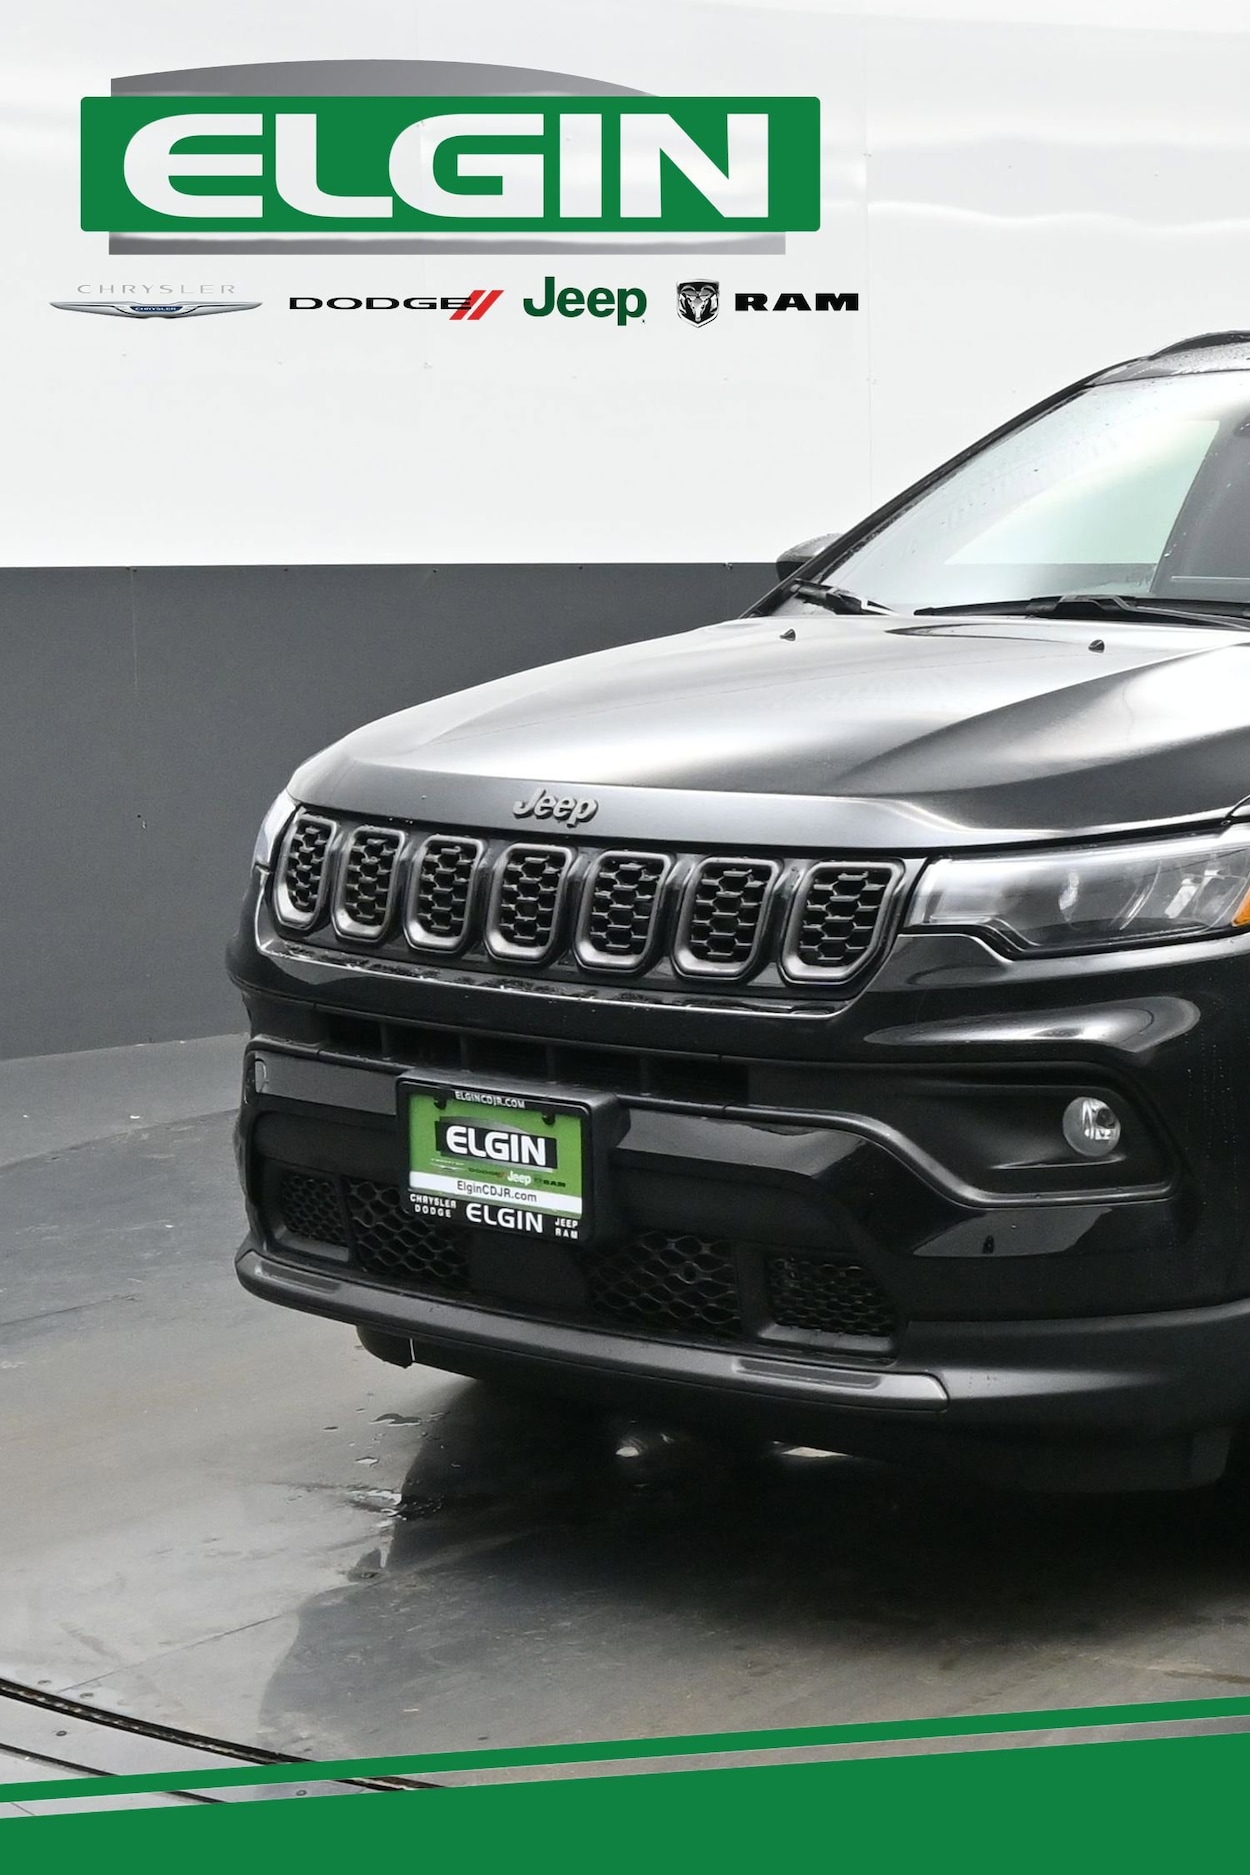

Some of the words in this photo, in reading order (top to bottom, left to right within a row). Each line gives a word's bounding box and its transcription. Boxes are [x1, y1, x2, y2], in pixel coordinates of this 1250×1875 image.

[513, 788, 598, 829] Jeep
[454, 1091, 526, 1109] ELGINCDJR.COM
[446, 1125, 547, 1167] ELGIN
[507, 1170, 532, 1186] Jeep
[456, 1180, 537, 1203] ElginCDJR.com
[409, 1193, 457, 1209] CHRYSLER
[414, 1205, 452, 1218] DODGE
[466, 1202, 543, 1234] ELGIN
[554, 1217, 578, 1229] JEEP
[554, 1228, 578, 1239] RAM
